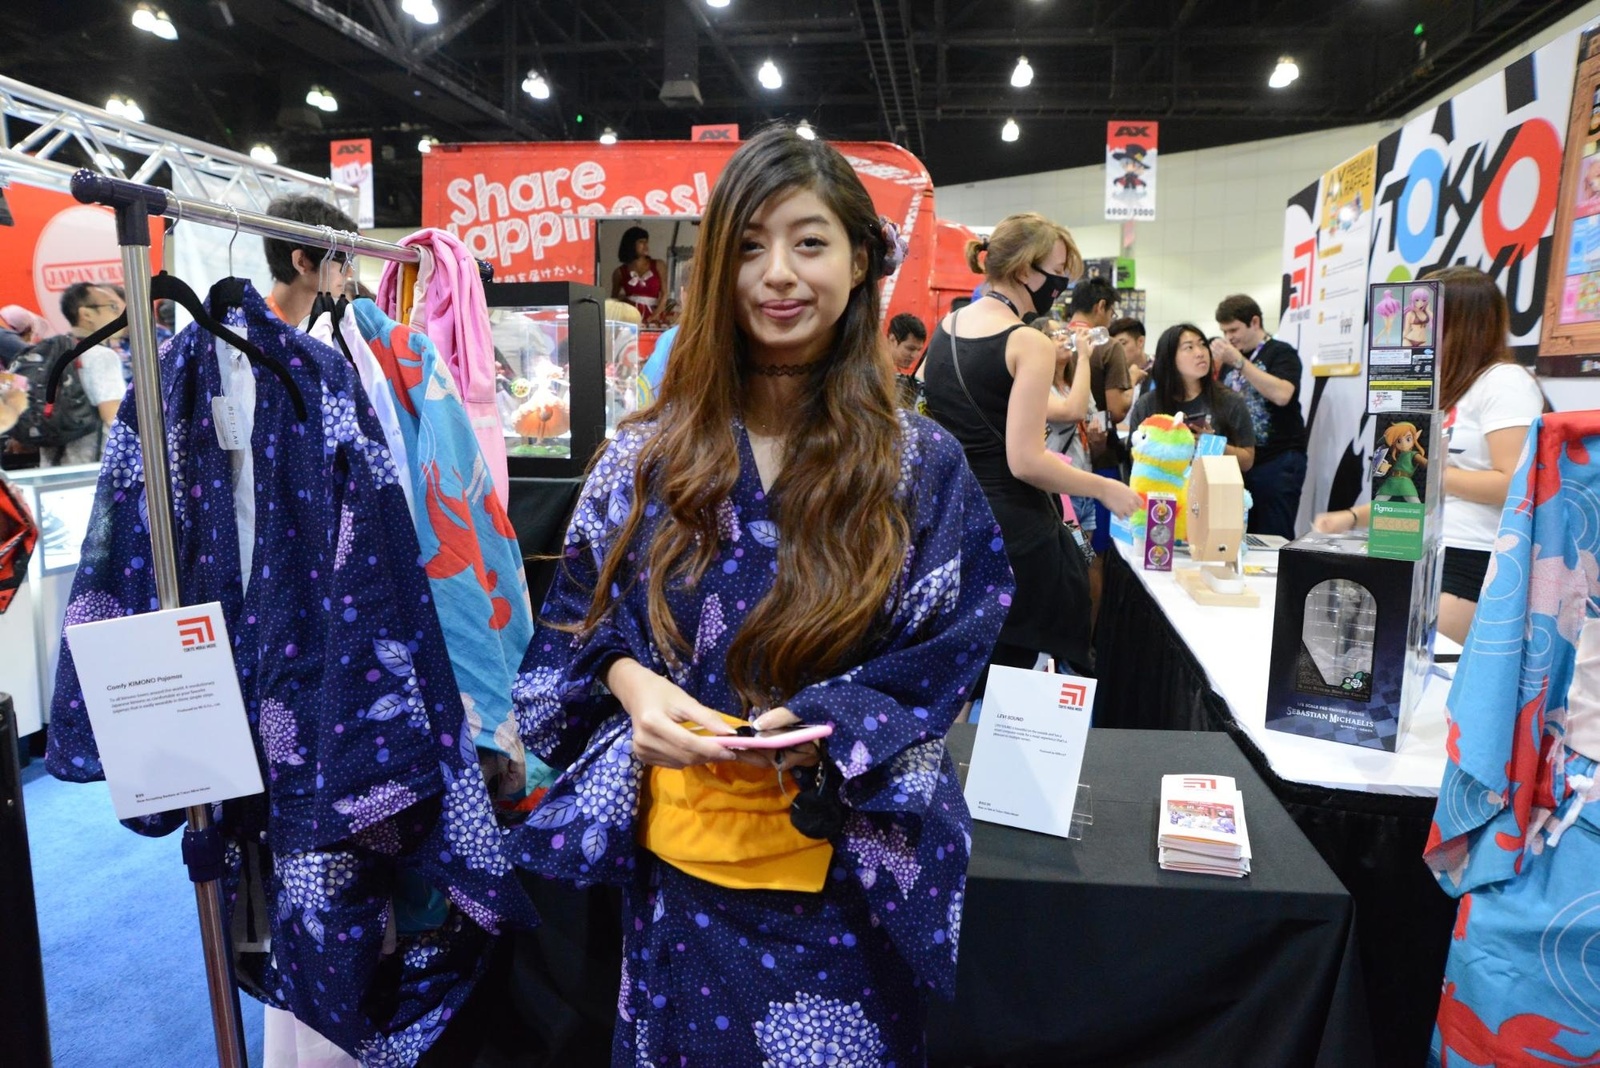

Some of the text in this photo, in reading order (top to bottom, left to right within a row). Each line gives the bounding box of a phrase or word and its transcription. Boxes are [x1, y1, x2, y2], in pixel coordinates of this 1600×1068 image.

[1114, 126, 1151, 137] AX
[446, 160, 606, 226] Share
[106, 683, 127, 691] Comfy
[128, 677, 156, 687] KIMONO
[1286, 706, 1374, 728] SEBASTIAN MICHAELIS
